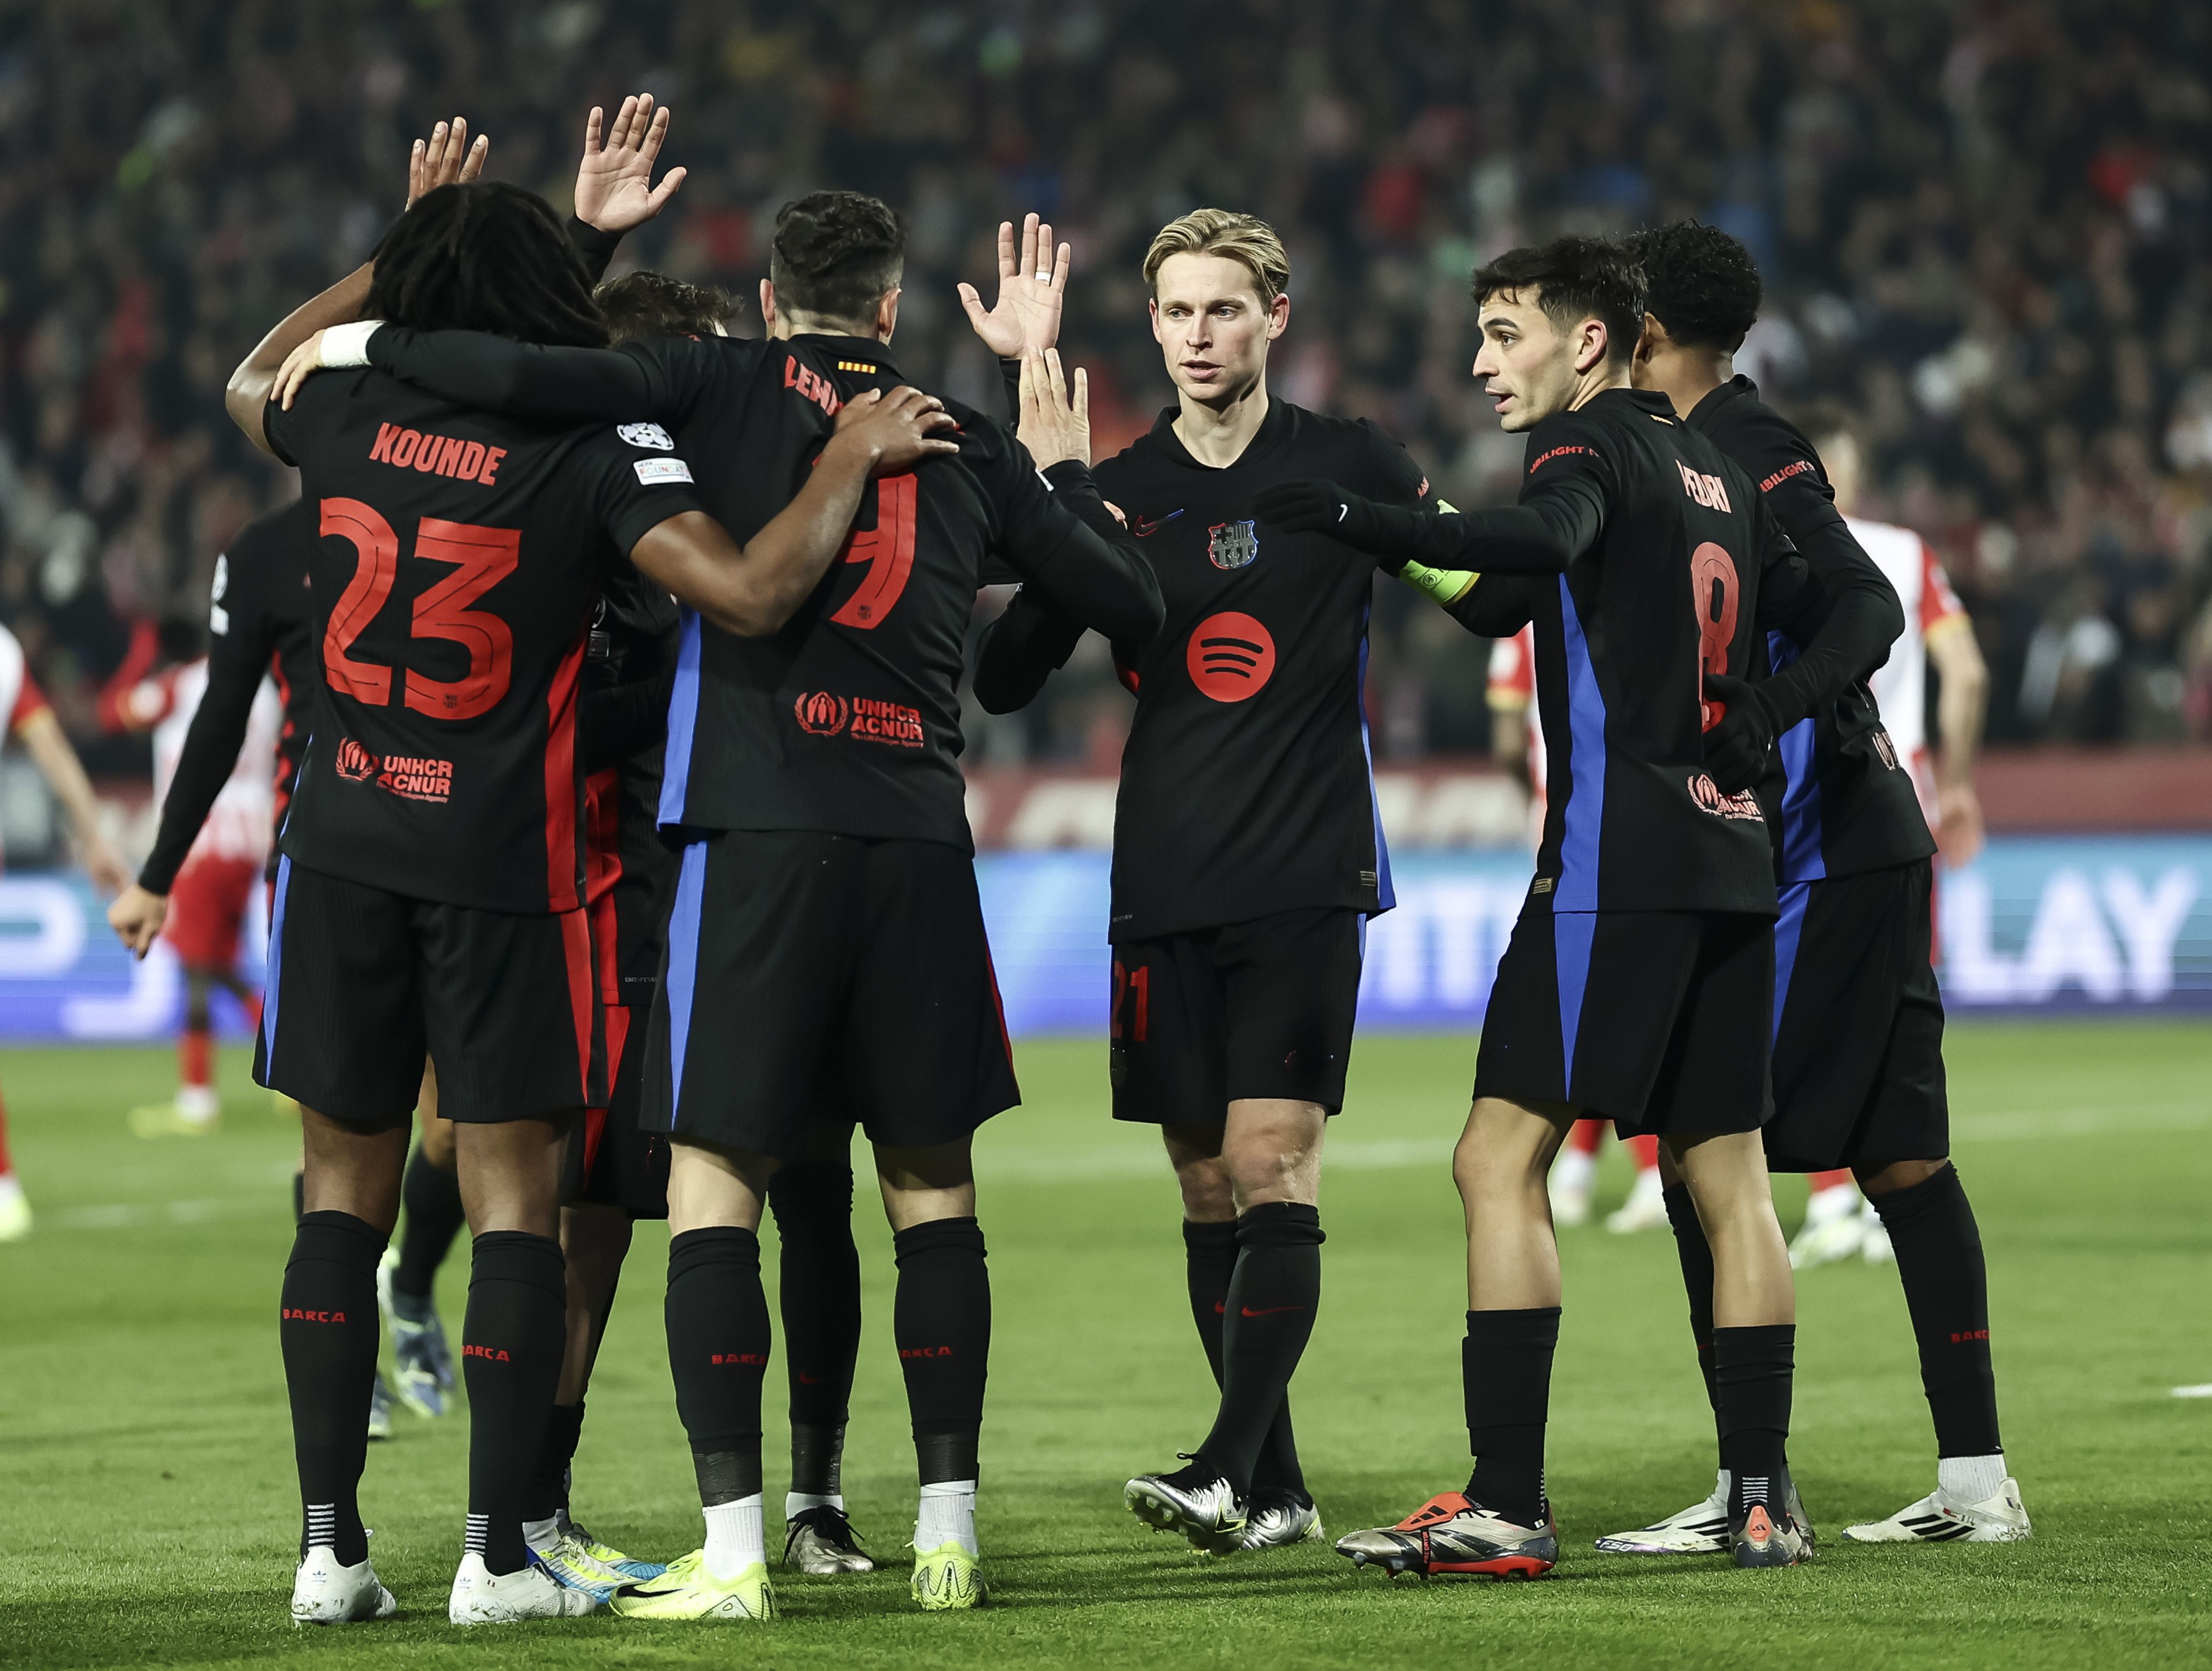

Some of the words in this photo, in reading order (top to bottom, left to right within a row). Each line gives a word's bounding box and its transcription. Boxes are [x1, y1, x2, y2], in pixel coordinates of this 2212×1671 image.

[369, 422, 507, 486] KOUNDE
[319, 497, 522, 720] 23
[850, 716, 924, 741] ACNUR
[853, 697, 921, 724] UNHCR
[384, 755, 453, 778] UNHCR
[1112, 961, 1149, 1042] 21
